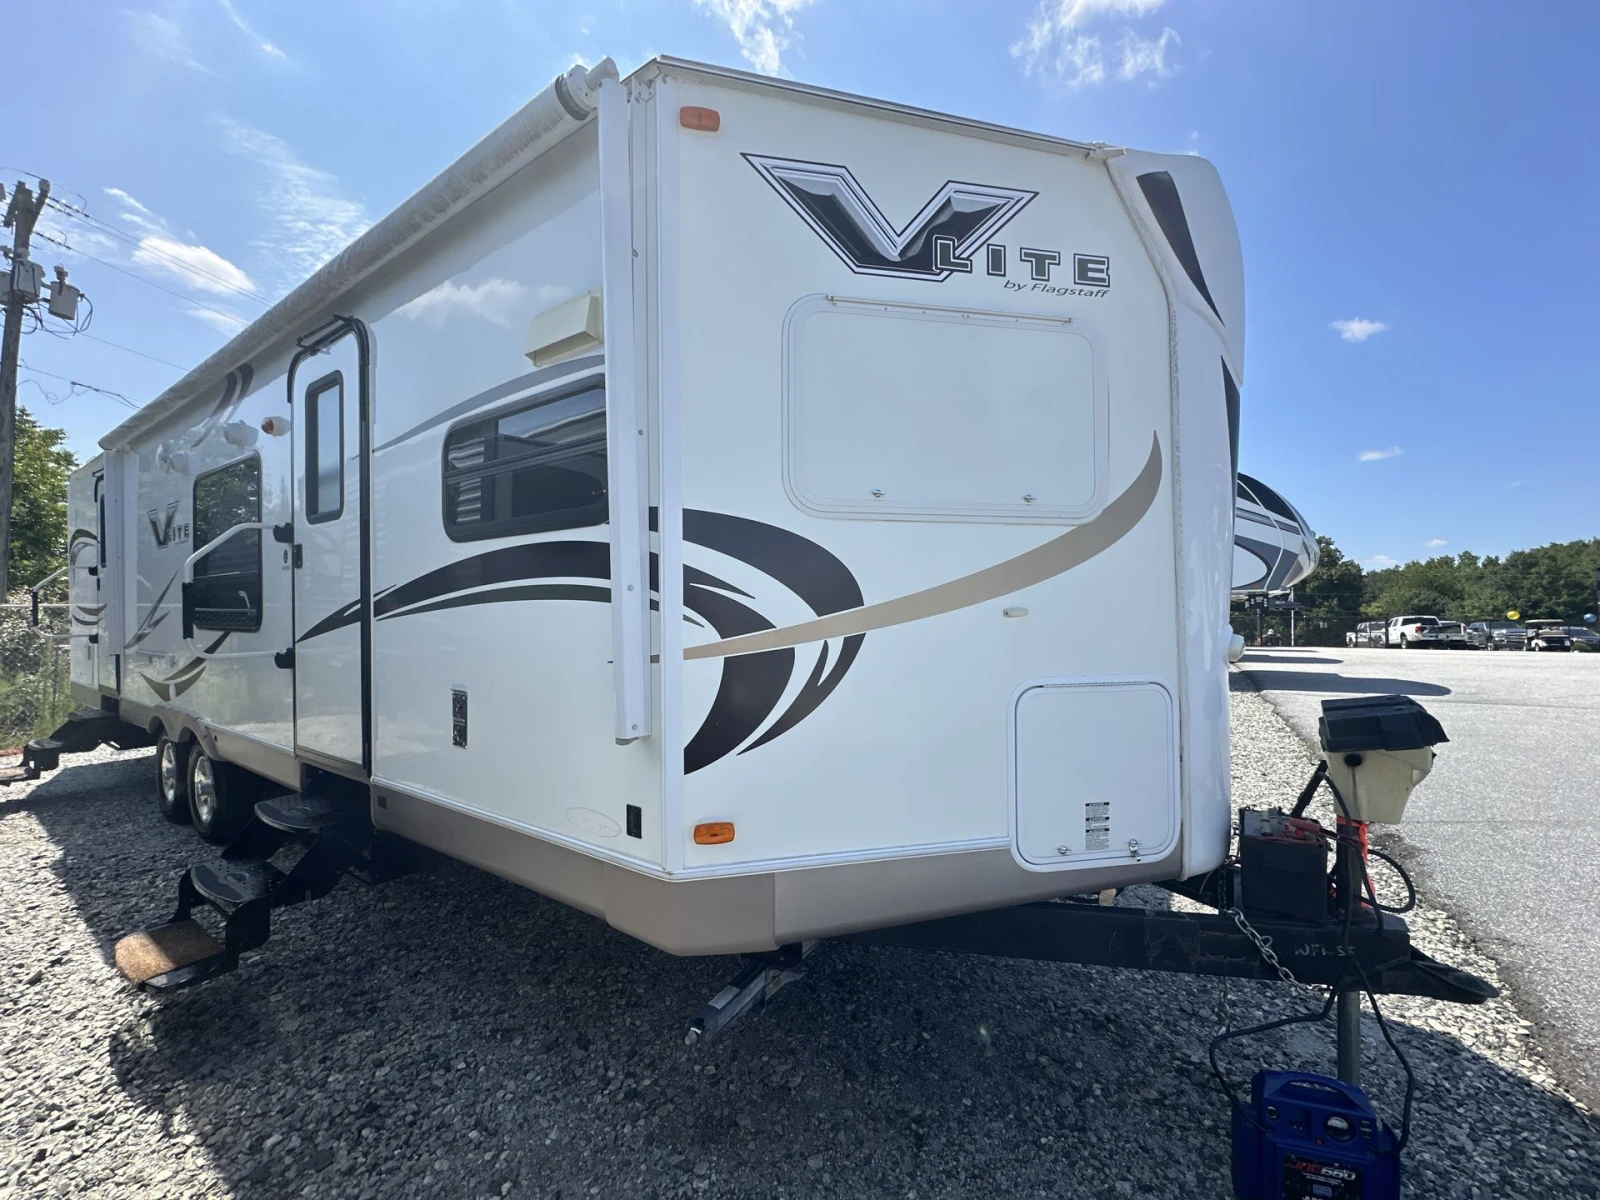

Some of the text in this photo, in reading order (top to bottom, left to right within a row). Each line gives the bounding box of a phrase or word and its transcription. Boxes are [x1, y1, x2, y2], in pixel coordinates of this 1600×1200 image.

[933, 235, 1111, 288] LITE
[1003, 280, 1110, 298] by Flagstaff
